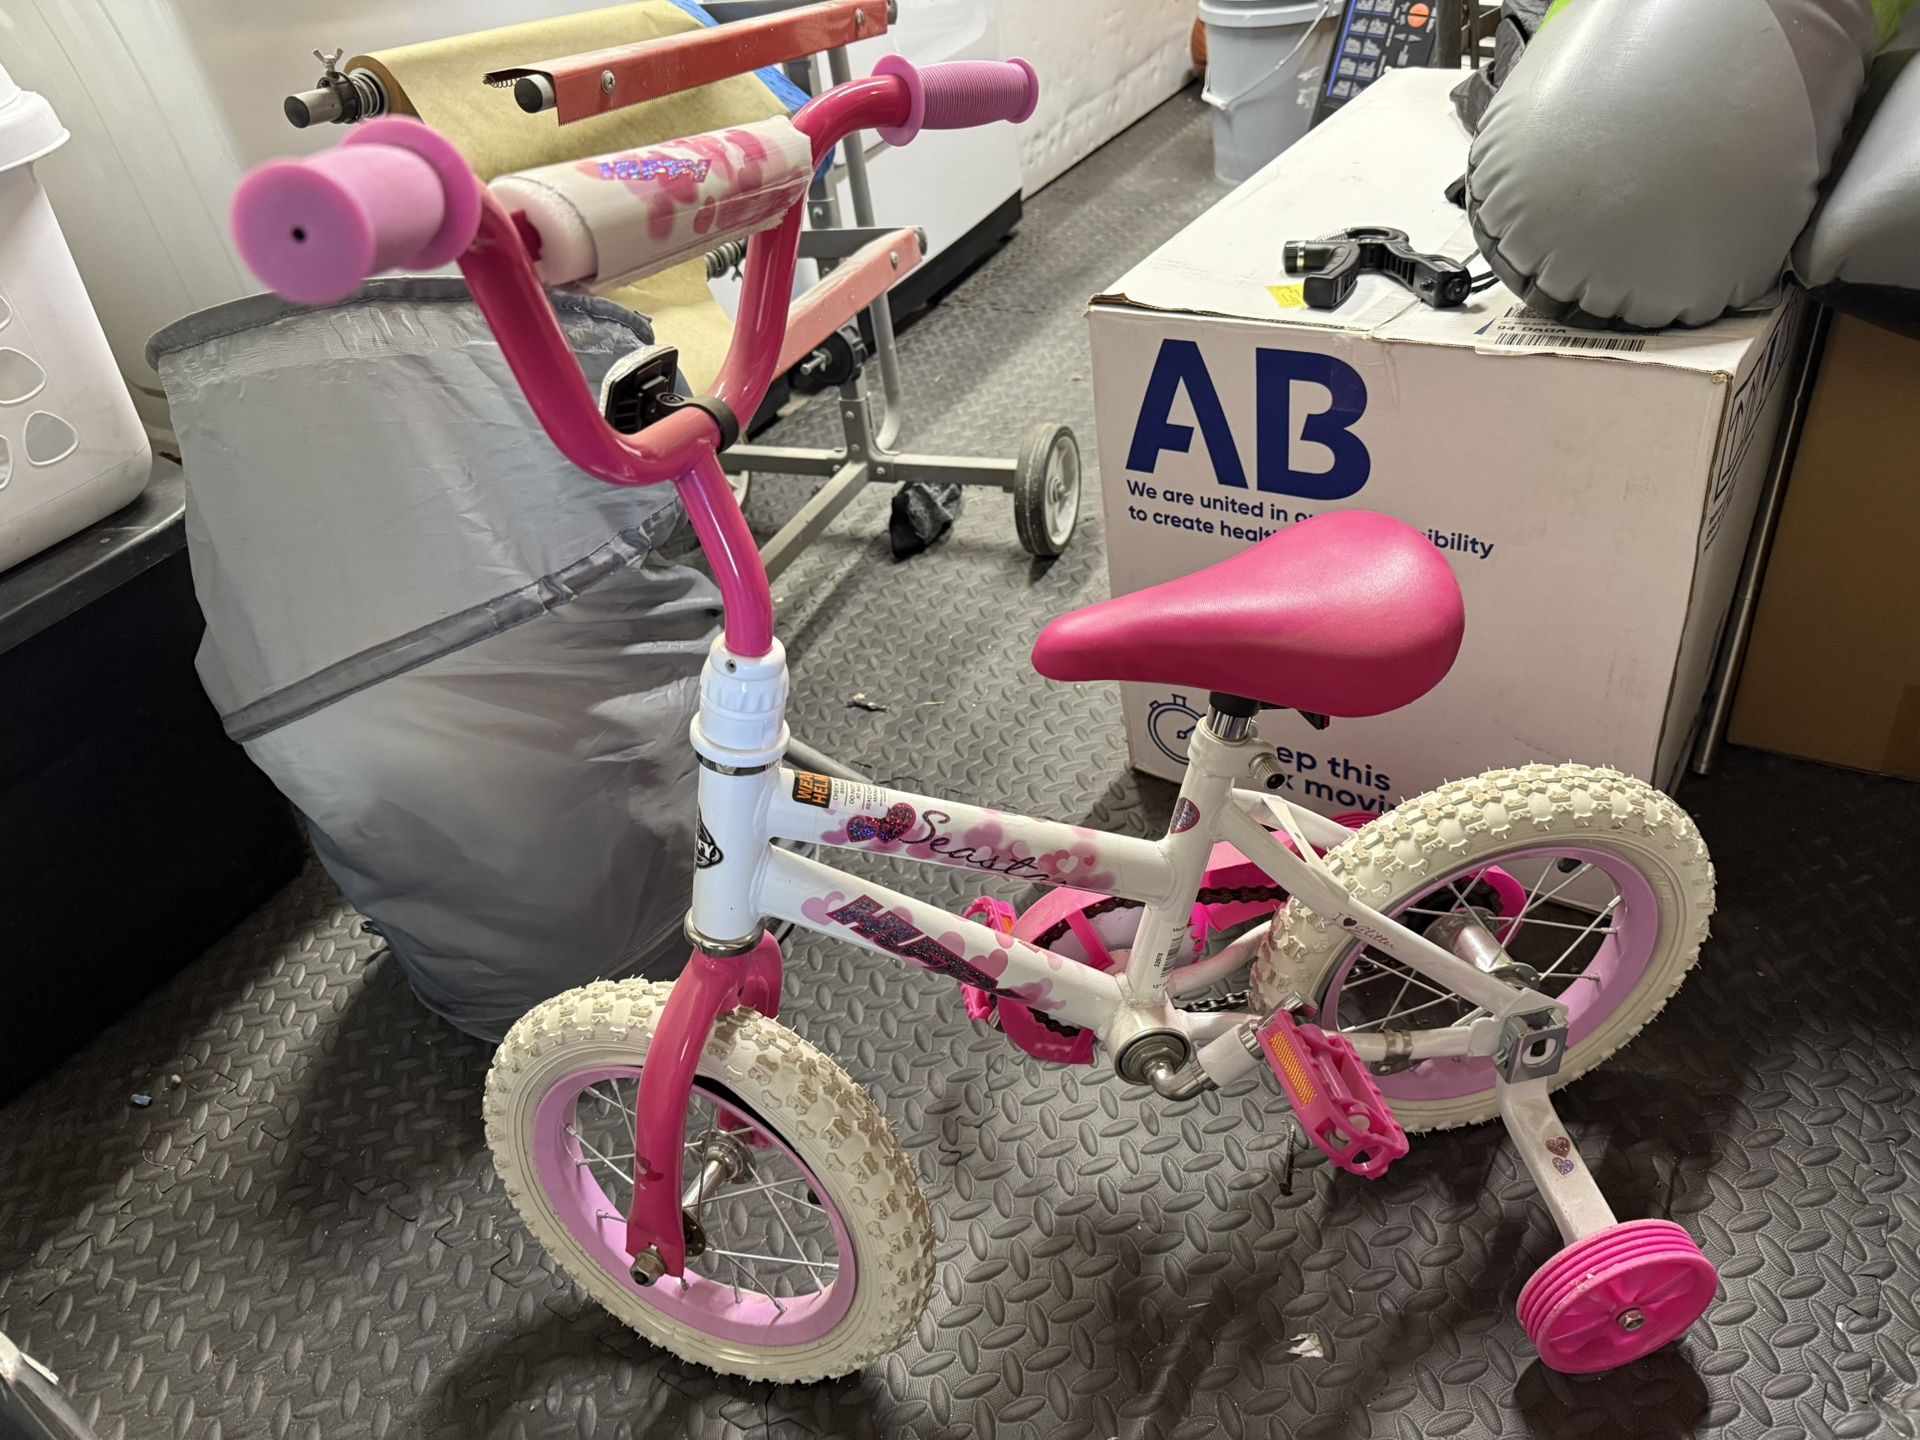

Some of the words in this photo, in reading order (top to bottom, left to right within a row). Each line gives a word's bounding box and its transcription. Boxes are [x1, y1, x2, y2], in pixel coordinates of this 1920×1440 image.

[1126, 479, 1157, 499] We
[1163, 489, 1194, 505] are
[1200, 496, 1264, 518] united
[1270, 503, 1289, 522] in
[1421, 528, 1495, 560] ibility
[1128, 505, 1147, 521] to
[1153, 511, 1214, 534] create
[1276, 746, 1317, 773] ep
[1327, 757, 1391, 791] this
